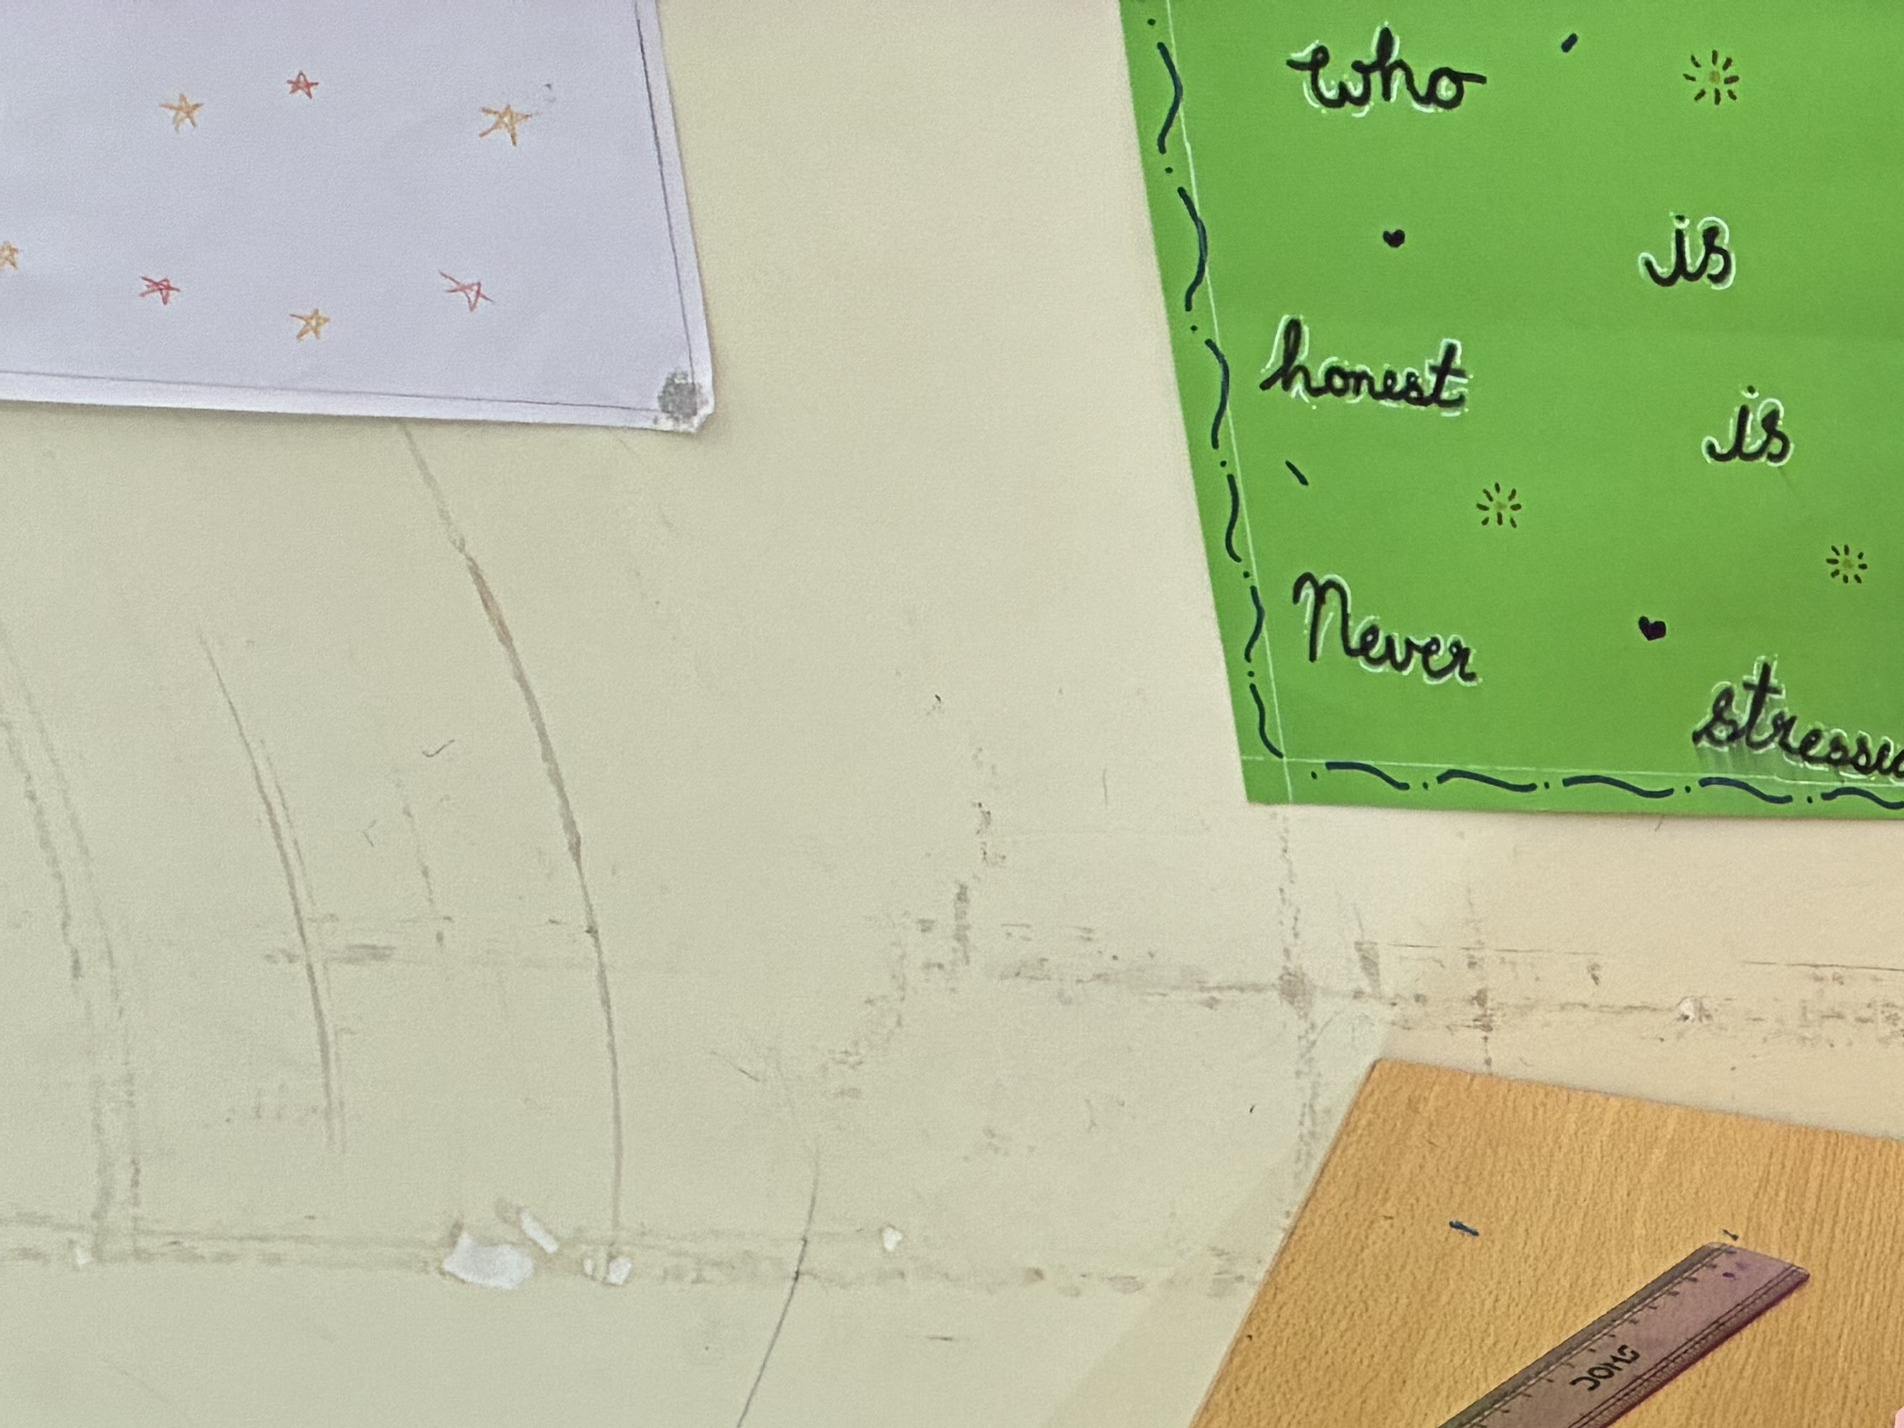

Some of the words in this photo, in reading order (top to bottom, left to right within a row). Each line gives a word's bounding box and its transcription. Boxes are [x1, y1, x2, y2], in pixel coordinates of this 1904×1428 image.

[1640, 213, 1736, 288] is
[1259, 318, 1468, 414] honest
[1702, 385, 1792, 466] is
[1293, 574, 1480, 686] Never
[1570, 1344, 1640, 1391] DOMS
